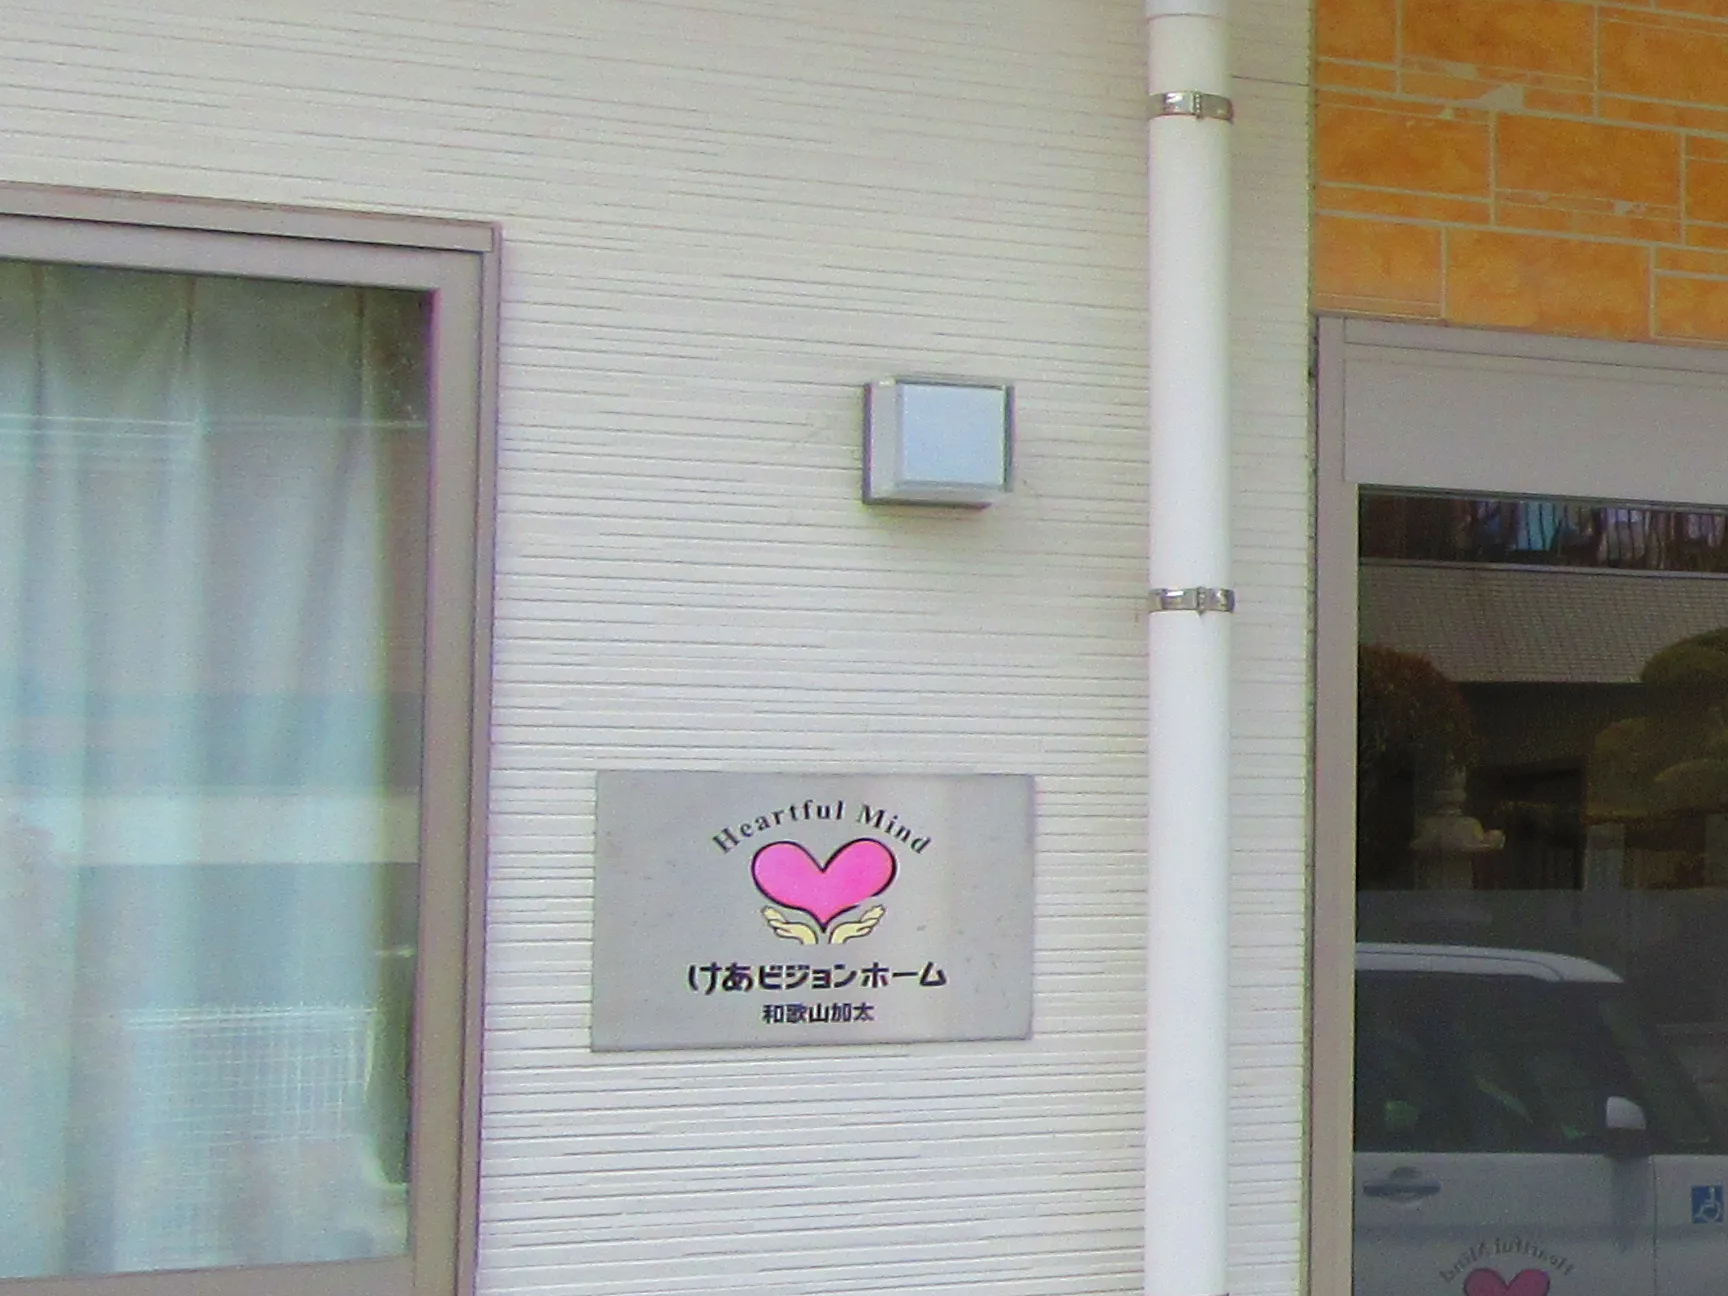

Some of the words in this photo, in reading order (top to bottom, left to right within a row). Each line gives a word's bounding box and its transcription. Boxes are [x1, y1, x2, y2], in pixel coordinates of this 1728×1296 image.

[711, 800, 844, 855] Heartful
[856, 804, 932, 855] Mind
[687, 961, 947, 995] けあビジョンホーム
[761, 1002, 876, 1024] 和歌山加太
